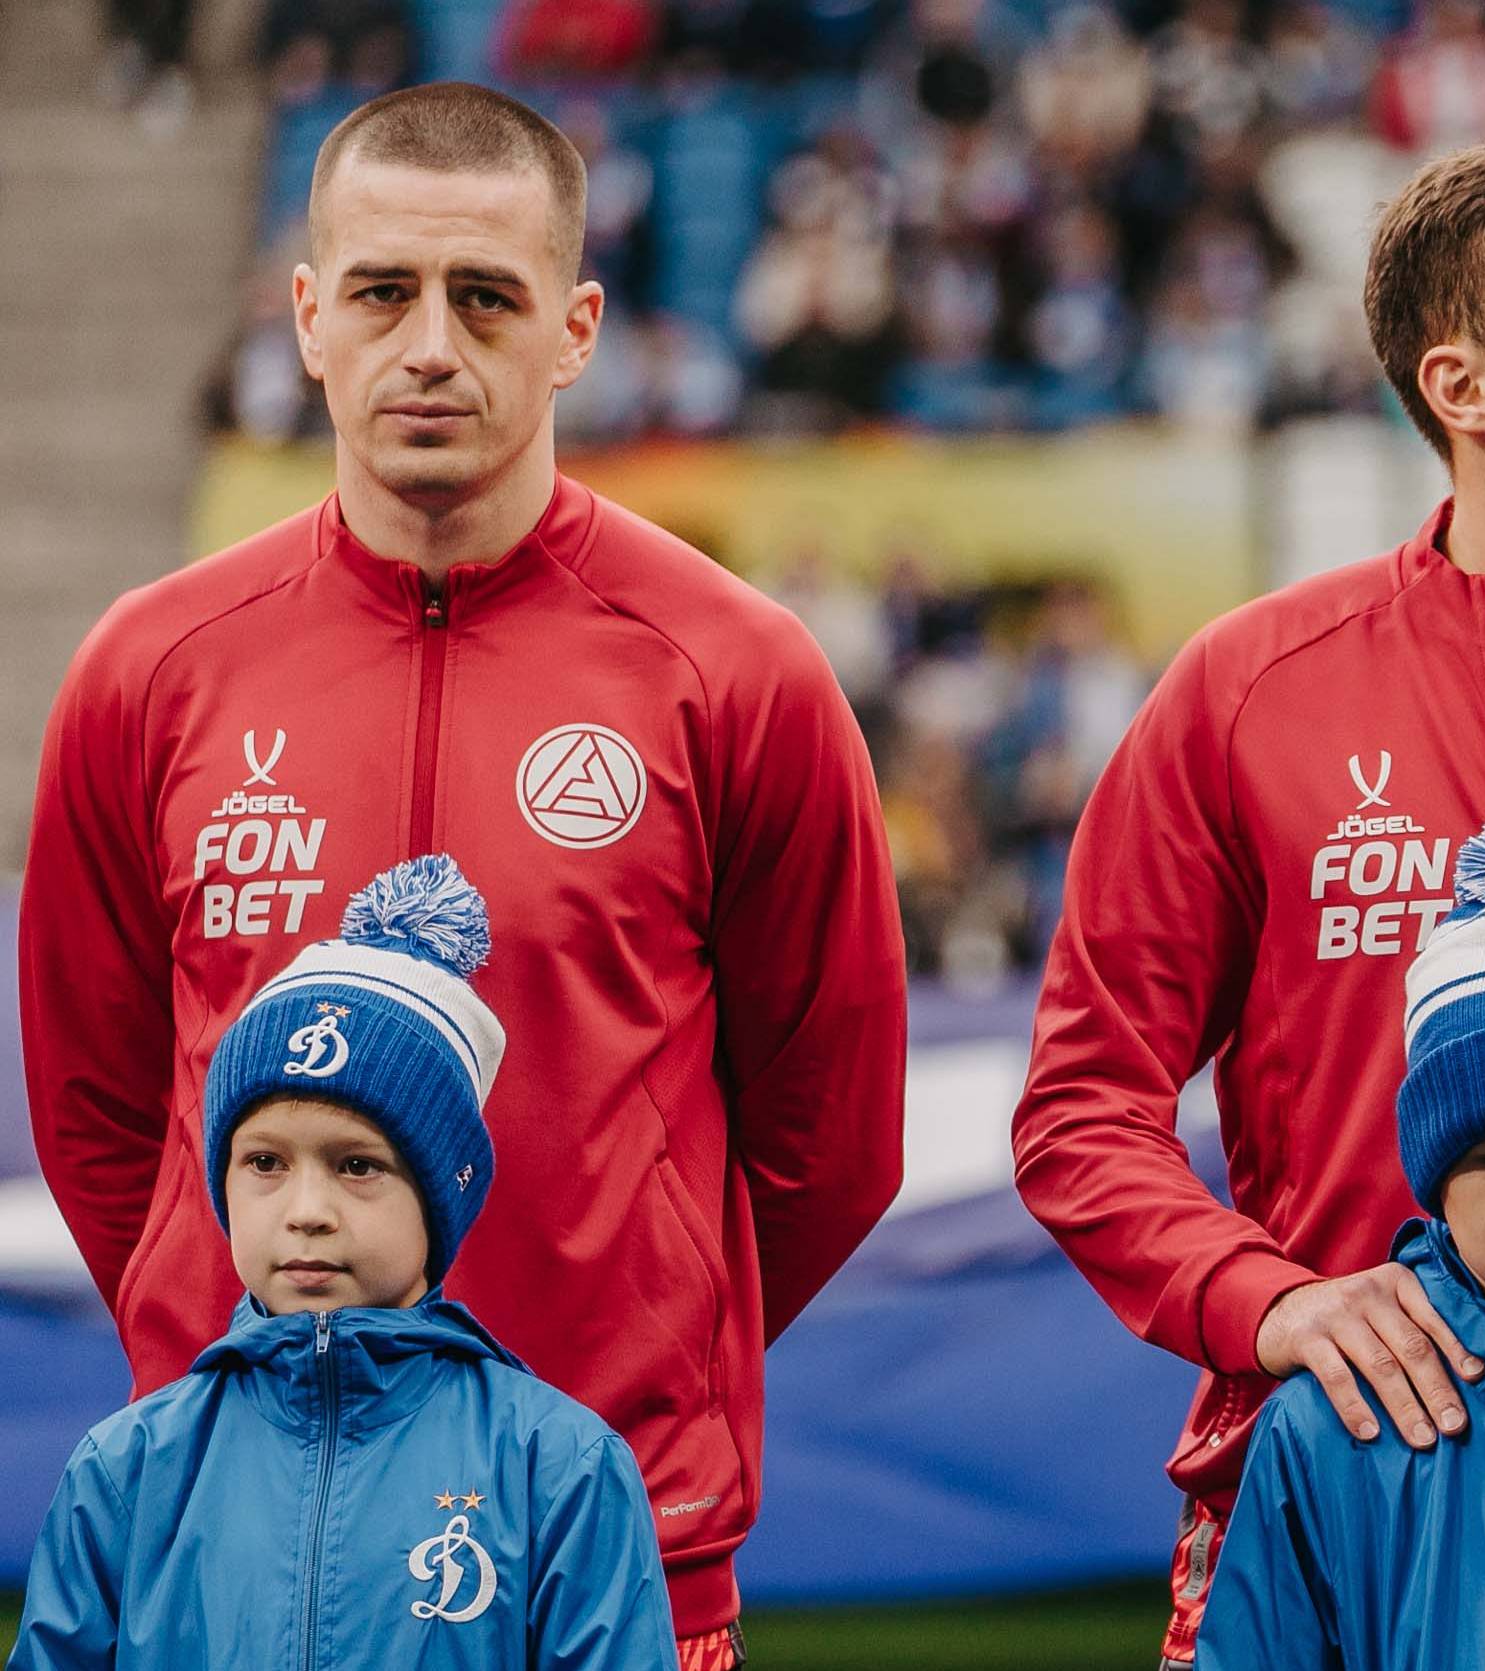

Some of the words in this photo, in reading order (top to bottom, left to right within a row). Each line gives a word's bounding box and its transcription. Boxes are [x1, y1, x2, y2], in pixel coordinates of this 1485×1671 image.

[212, 791, 306, 817] JÖGEL
[1327, 814, 1425, 840] JÖGEL
[194, 818, 326, 880] FON
[1311, 838, 1450, 899] FON
[204, 880, 324, 938] BET
[1317, 899, 1454, 960] BET
